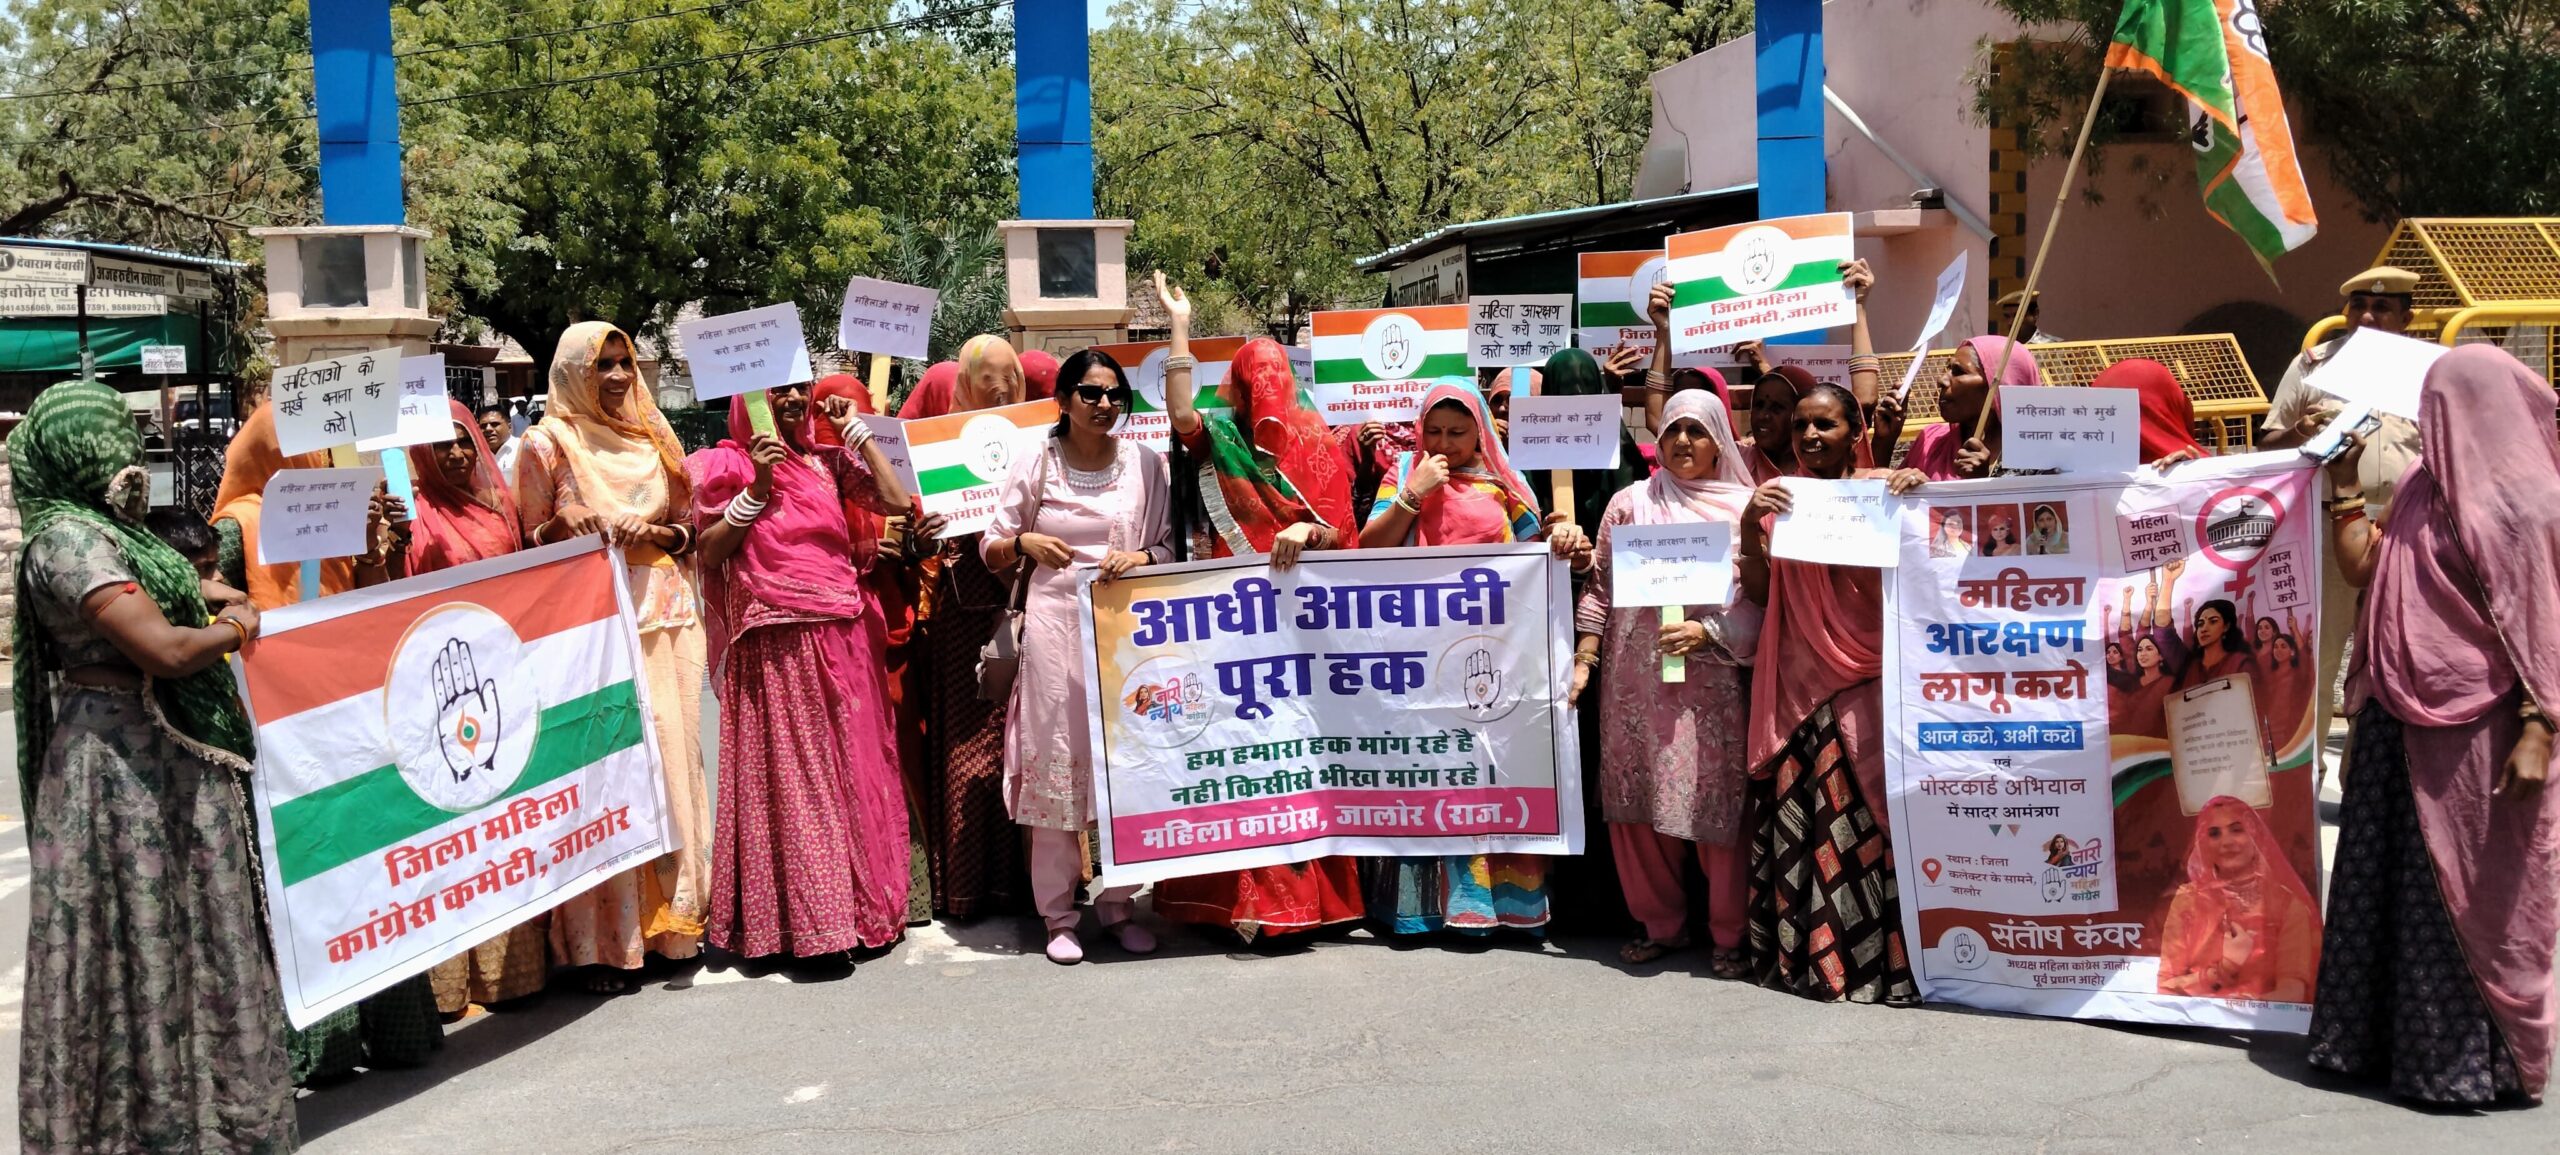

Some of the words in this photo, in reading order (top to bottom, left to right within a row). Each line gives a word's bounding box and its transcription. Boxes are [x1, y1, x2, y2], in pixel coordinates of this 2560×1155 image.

[17, 256, 52, 269] देवाराम
[54, 258, 85, 271] देवासी
[892, 298, 903, 312] को
[1479, 302, 1513, 319] महिला
[1521, 303, 1563, 319] आरक्षण
[1711, 299, 1752, 316] जिला
[1756, 290, 1807, 308] महिला
[852, 317, 876, 330] बनाना
[879, 318, 891, 331] बंद
[894, 321, 908, 334] करो
[1684, 318, 1730, 338] कांग्रेस
[1734, 309, 1786, 330] कमेटी,
[1787, 301, 1838, 320] जालोर
[697, 327, 724, 341] महिला
[727, 323, 757, 336] आरक्षण
[761, 318, 780, 330] लागू
[1512, 320, 1530, 336] करो
[1539, 323, 1564, 337] आज
[713, 345, 730, 357] करो
[734, 342, 751, 353] आज
[755, 338, 770, 349] करो
[1480, 341, 1502, 357] करो
[1508, 342, 1534, 357] अभी
[357, 356, 375, 376] को
[729, 364, 747, 375] अभी
[751, 359, 765, 370] करो
[1781, 357, 1803, 366] महिला
[1807, 358, 1832, 366] आरक्षण
[1828, 374, 1841, 382] करो
[322, 388, 353, 406] बनाना
[365, 381, 386, 399] बंद
[1353, 382, 1390, 396] जिला
[1393, 380, 1431, 394] महिल
[1327, 397, 1370, 412] कांग्रेस
[1373, 395, 1421, 410] कमेटी,
[2015, 404, 2066, 418] महिलाओ
[2073, 403, 2089, 417] को
[1130, 414, 1167, 426] जिला
[1520, 412, 1562, 424] महिलाओ
[1567, 410, 1580, 423] को
[1521, 434, 1550, 445] बनाना
[1556, 432, 1570, 445] बंद
[1574, 432, 1591, 444] करो
[2019, 429, 2054, 443] बनाना
[2061, 427, 2078, 442] बंद
[2082, 427, 2104, 442] करो
[891, 456, 905, 467] बंद
[279, 480, 306, 494] महिला
[307, 482, 337, 493] आरक्षण
[339, 480, 357, 492] लागू
[962, 486, 1000, 502] जिला
[286, 502, 301, 513] करो
[304, 503, 321, 512] आज
[325, 500, 339, 510] करो
[1861, 495, 1880, 506] लागू
[296, 526, 311, 536] अभी
[315, 523, 328, 533] करो
[2130, 513, 2169, 531] महिला
[1627, 538, 1652, 548] महिला
[1657, 537, 1686, 546] आरक्षण
[1691, 536, 1709, 546] लागू
[2131, 529, 2177, 546] आरक्षण
[1681, 554, 1696, 563] करो
[2131, 546, 2157, 563] लागू
[2159, 541, 2182, 557] करो
[2268, 550, 2292, 565] आज
[2271, 561, 2292, 579] करो
[1958, 568, 2086, 612] महिला
[2273, 575, 2296, 592] अभी
[2277, 589, 2298, 605] करो
[1132, 576, 1281, 648] आधी
[1295, 568, 1510, 630] आबादी
[1926, 619, 2084, 658] आरक्षण
[1215, 652, 1316, 721] पूरा
[1323, 650, 1428, 697] हक
[1920, 670, 2012, 714] लागू
[2012, 659, 2088, 701] करो
[1155, 677, 1183, 712] नारी
[1149, 703, 1183, 721] न्याय
[1921, 729, 1959, 745] आज
[1961, 725, 1998, 748] करो,
[2003, 724, 2040, 745] अभी
[2042, 722, 2076, 744] करो
[1186, 749, 1225, 771] हम
[1230, 740, 1303, 766] हमारा
[1309, 736, 1352, 757] हक
[1357, 730, 1410, 756] मांग
[1416, 728, 1451, 756] रहे
[1457, 728, 1475, 754] है
[1993, 755, 2012, 769] एवं
[1170, 777, 1219, 806] नही
[1226, 762, 1313, 800] किसीसे
[1318, 764, 1380, 788] भीख
[1386, 760, 1440, 788] मांग
[1445, 759, 1480, 786] रहे
[1919, 774, 1998, 797] पोस्टकार्ड
[2005, 775, 2086, 796] अभियान
[1947, 801, 1959, 819] में
[1963, 805, 1998, 819] सादर
[2003, 801, 2059, 820] आमंत्रण
[1141, 816, 1234, 850] महिला
[1238, 803, 1328, 837] कांग्रेस,
[1336, 797, 1426, 828] जालोर
[1434, 797, 1530, 831] (राज.)
[384, 823, 477, 886] जिला
[484, 784, 581, 842] महिला
[2072, 838, 2102, 863] नारी
[1947, 854, 1973, 868] स्थान
[1981, 855, 2009, 868] जिला
[2062, 861, 2103, 878] न्याय
[325, 892, 437, 965] कांग्रेस
[441, 846, 548, 915] कमेटी,
[549, 805, 631, 867] जालोर
[1948, 869, 1988, 884] कलेक्टर
[1991, 869, 2002, 883] के
[2003, 869, 2037, 886] सामने,
[1991, 917, 2064, 950] संतोष
[2072, 918, 2144, 950] कंवर
[2006, 958, 2037, 971] अध्यक्ष
[2039, 957, 2069, 971] महिला
[2072, 957, 2101, 973] कांग्रेस
[2033, 970, 2049, 986] पूर्व
[2050, 973, 2076, 986] प्रधान
[2078, 971, 2105, 986] आहोर
